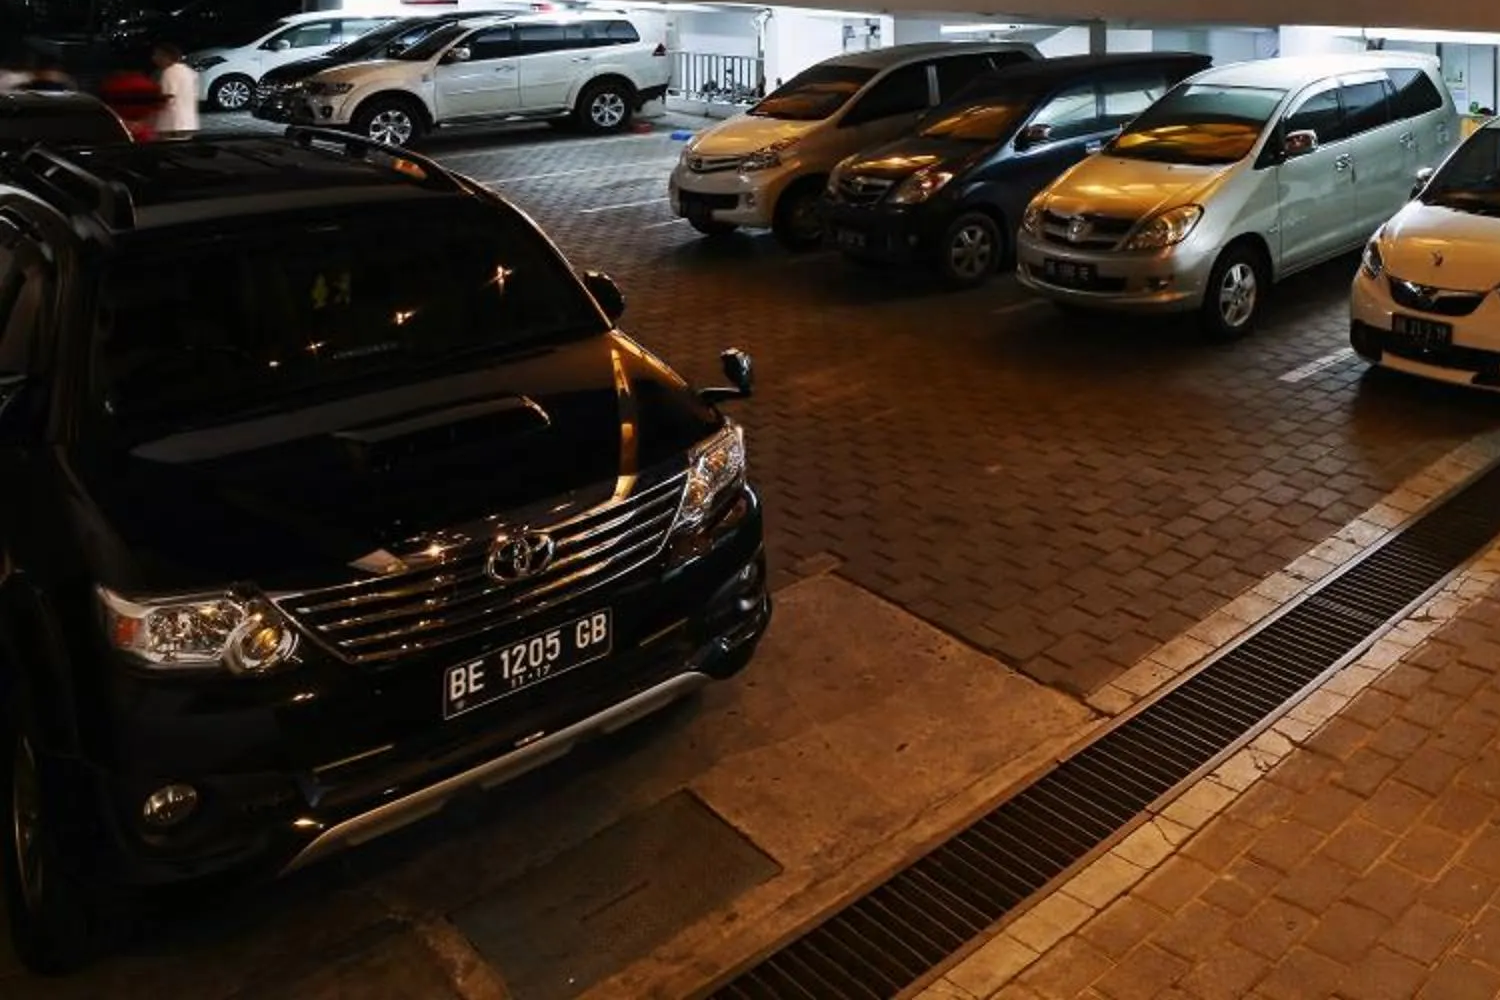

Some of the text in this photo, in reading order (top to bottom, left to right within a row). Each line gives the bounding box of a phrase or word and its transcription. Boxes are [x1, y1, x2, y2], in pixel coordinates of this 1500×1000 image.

[450, 613, 607, 700] BE 1205 GB
